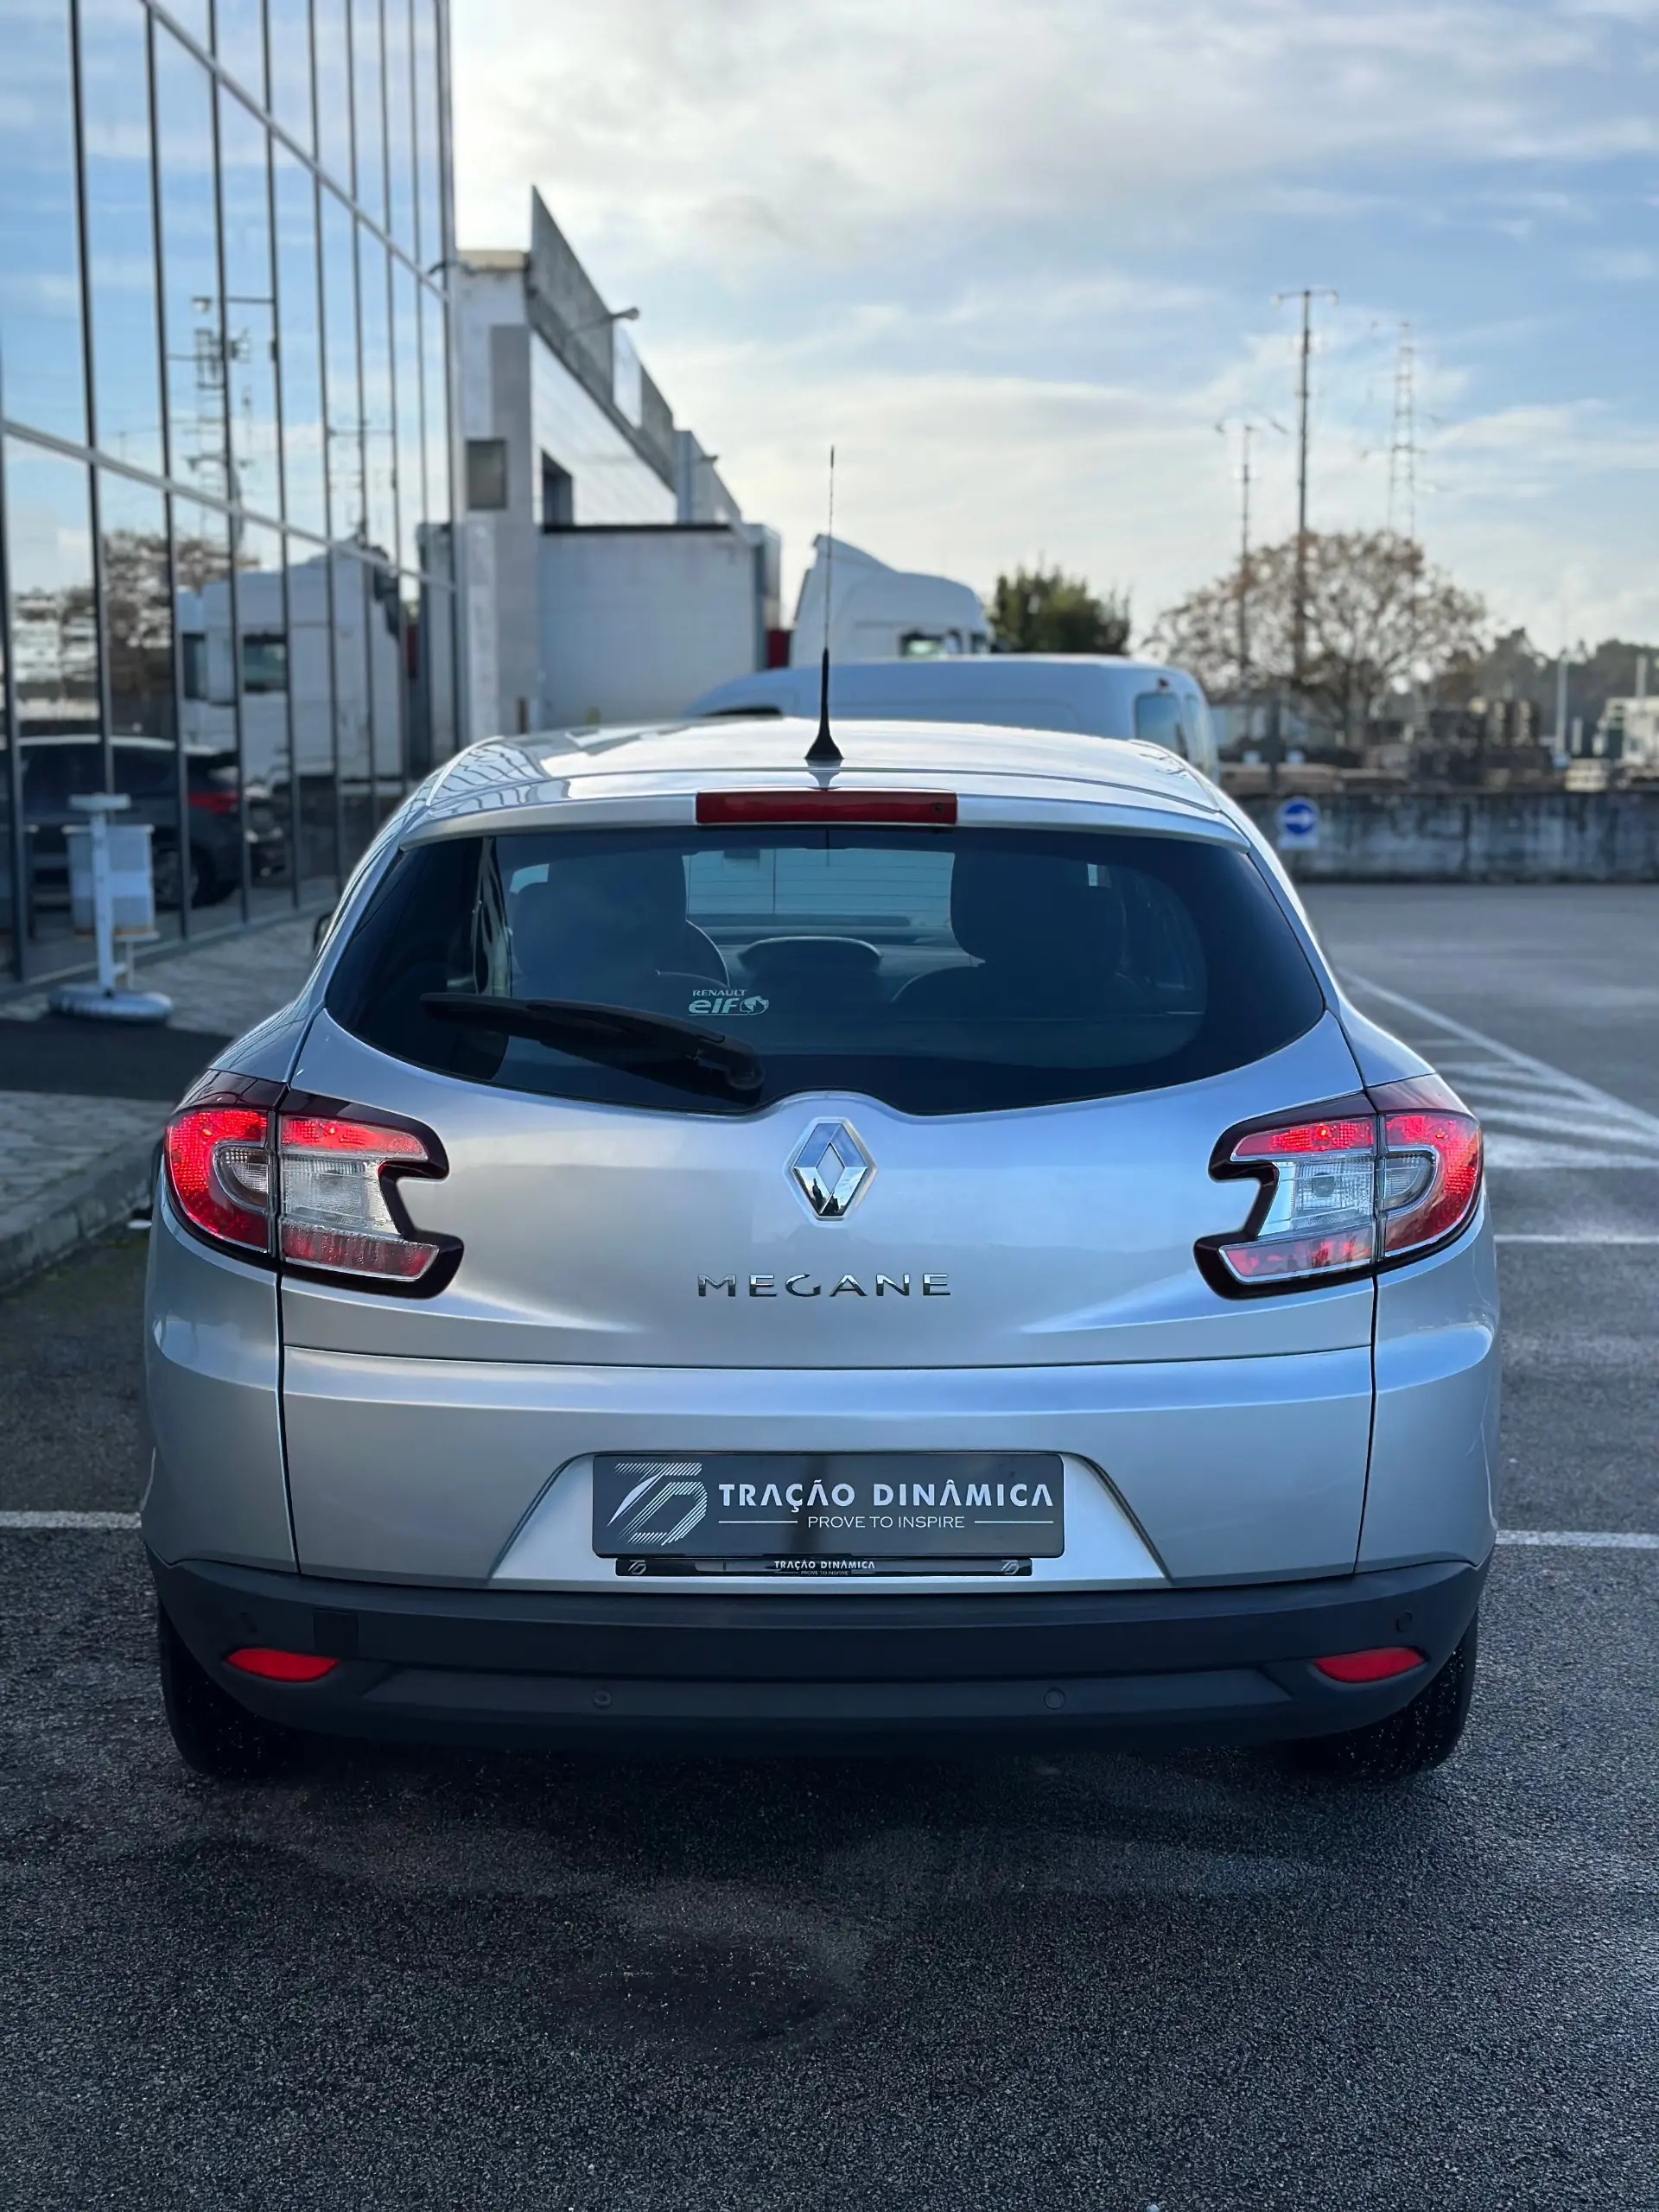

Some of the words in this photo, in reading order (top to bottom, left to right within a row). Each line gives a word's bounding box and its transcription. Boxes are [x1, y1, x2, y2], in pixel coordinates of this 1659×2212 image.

[688, 997, 740, 1014] elf
[697, 1273, 951, 1297] MEGANE
[718, 1479, 855, 1513] TRAÇÃO
[874, 1479, 1054, 1507] DINÂMICA
[808, 1516, 866, 1529] PROVE
[869, 1516, 893, 1529] TO
[899, 1516, 965, 1529] INSPIRE
